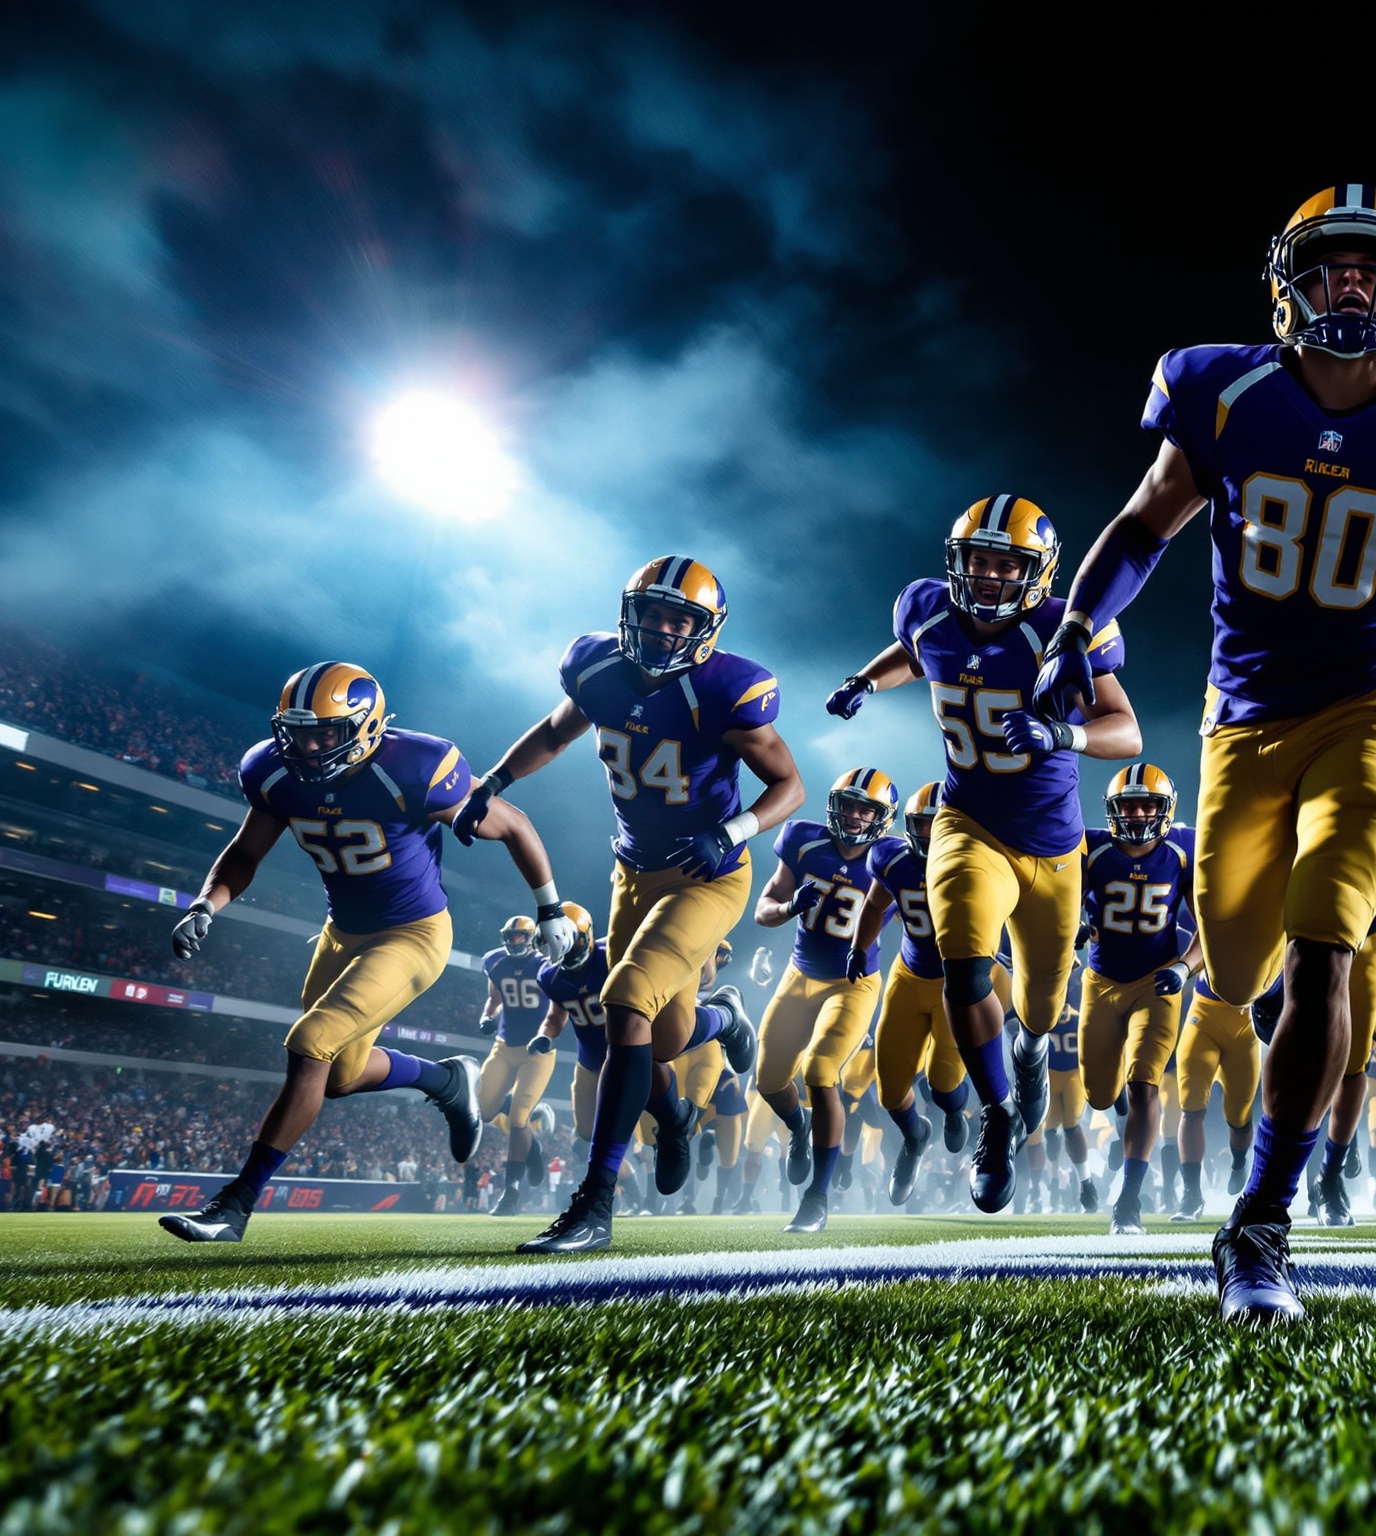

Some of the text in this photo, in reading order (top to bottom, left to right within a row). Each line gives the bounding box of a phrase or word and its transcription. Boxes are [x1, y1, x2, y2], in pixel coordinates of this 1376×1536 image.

[930, 680, 1032, 774] 55
[598, 726, 690, 805] 34
[290, 816, 392, 875] 52
[1103, 881, 1172, 933] 25
[501, 978, 541, 1009] 86
